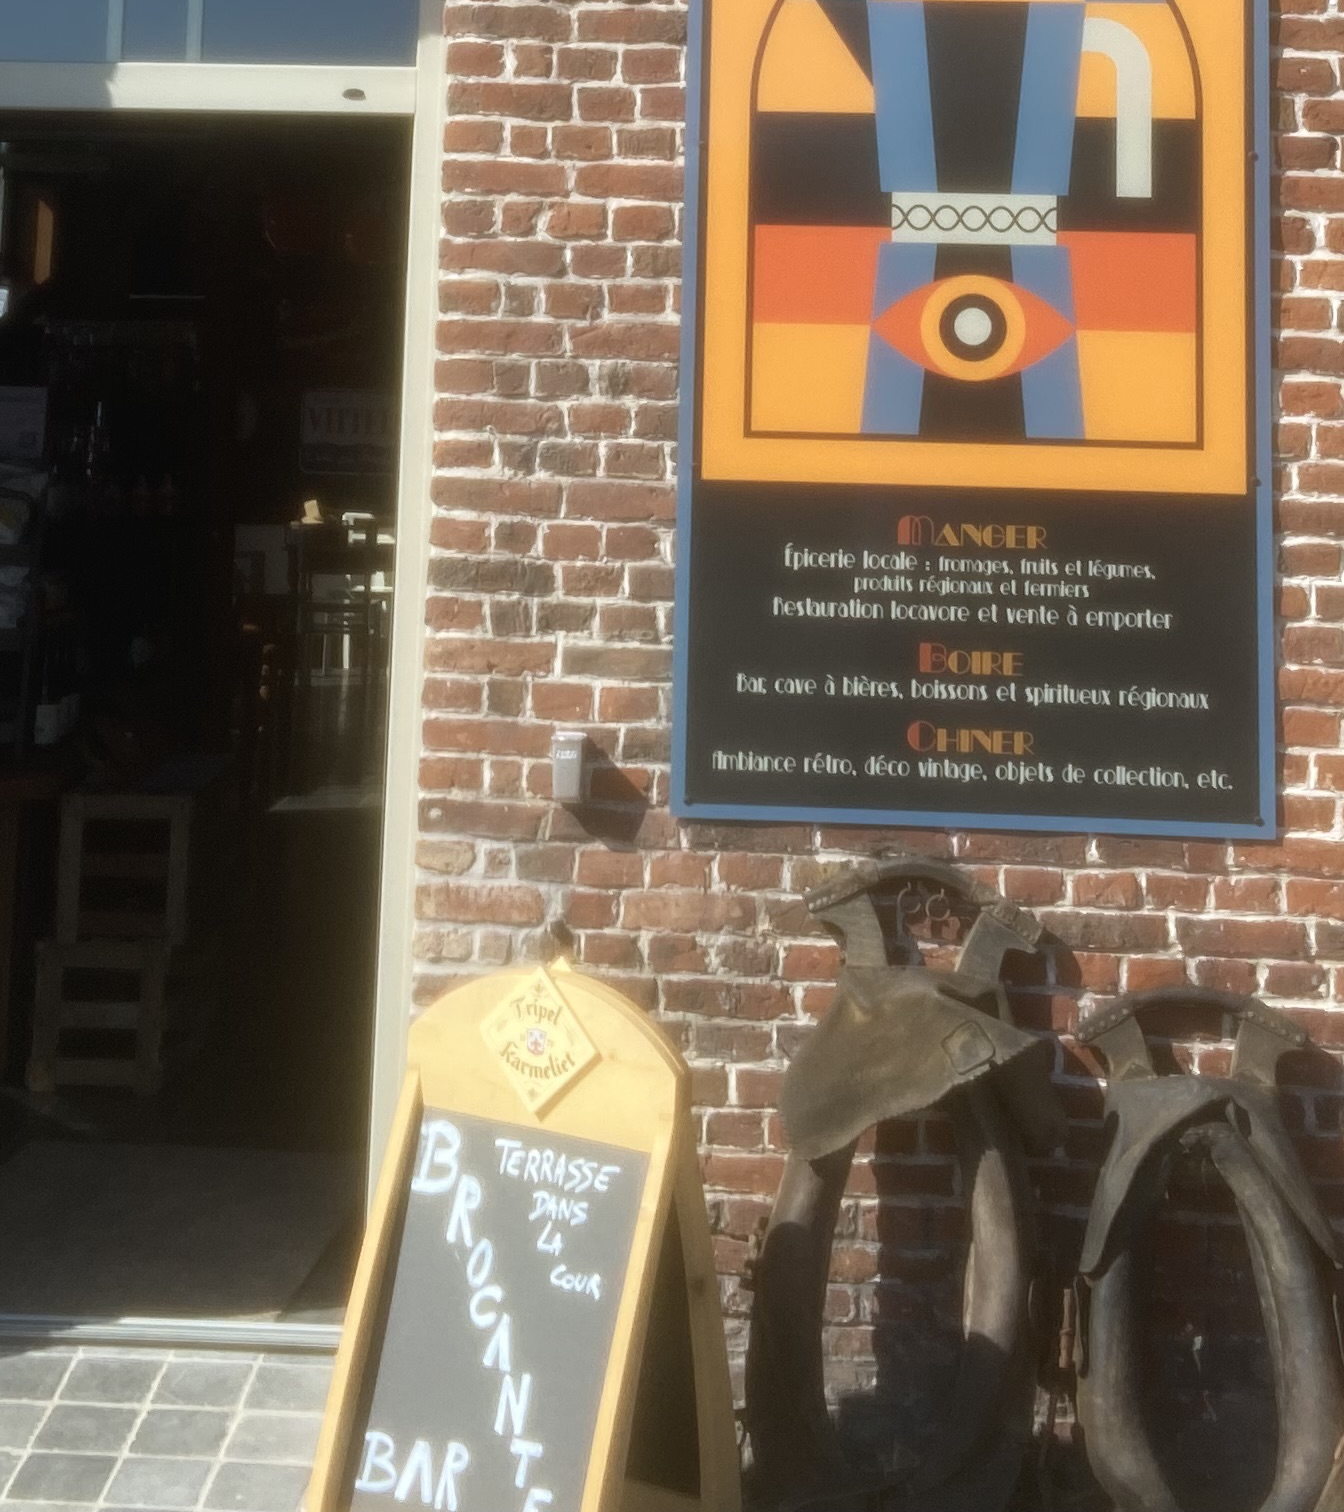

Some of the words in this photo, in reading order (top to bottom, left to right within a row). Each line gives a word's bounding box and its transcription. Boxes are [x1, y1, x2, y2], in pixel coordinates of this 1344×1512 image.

[897, 514, 1049, 550] MANGER
[783, 542, 856, 571] Épicerie
[862, 550, 918, 571] locale
[938, 555, 1014, 576] fromages,
[1020, 558, 1058, 576] fruits
[1064, 559, 1083, 577] et
[1088, 558, 1157, 581] légumes,
[854, 575, 914, 594] produits
[918, 574, 994, 597] régionaux
[999, 579, 1019, 596] et
[1023, 580, 1091, 599] fermiers
[771, 595, 885, 620] Restauration
[890, 599, 971, 622] locavore
[977, 603, 998, 624] et
[1006, 605, 1060, 626] vente
[1065, 604, 1079, 627] à
[1085, 608, 1174, 632] emporter
[918, 642, 1025, 676] BOIRE
[774, 677, 818, 695] cave
[823, 673, 836, 696] à
[842, 675, 904, 700] bières,
[910, 679, 989, 702] boissons
[996, 682, 1016, 703] et
[1024, 683, 1111, 707] spiritueux
[1117, 684, 1210, 711] régionaux
[906, 719, 1036, 755] CHINER
[712, 750, 797, 773] Ambiance
[803, 752, 858, 776] rétro,
[864, 754, 911, 777] déco
[917, 758, 989, 783] vintage,
[995, 761, 1055, 785] objets
[1062, 763, 1086, 785] de
[1093, 765, 1190, 790] collection,
[1196, 769, 1234, 791] etc.
[509, 996, 563, 1026] Tripel
[499, 1041, 576, 1080] Karmeliet
[494, 1137, 622, 1194] TERRASSE
[528, 1189, 589, 1226] DANS
[536, 1222, 564, 1257] LA
[549, 1263, 601, 1301] COUR
[355, 1431, 471, 1512] BAR
